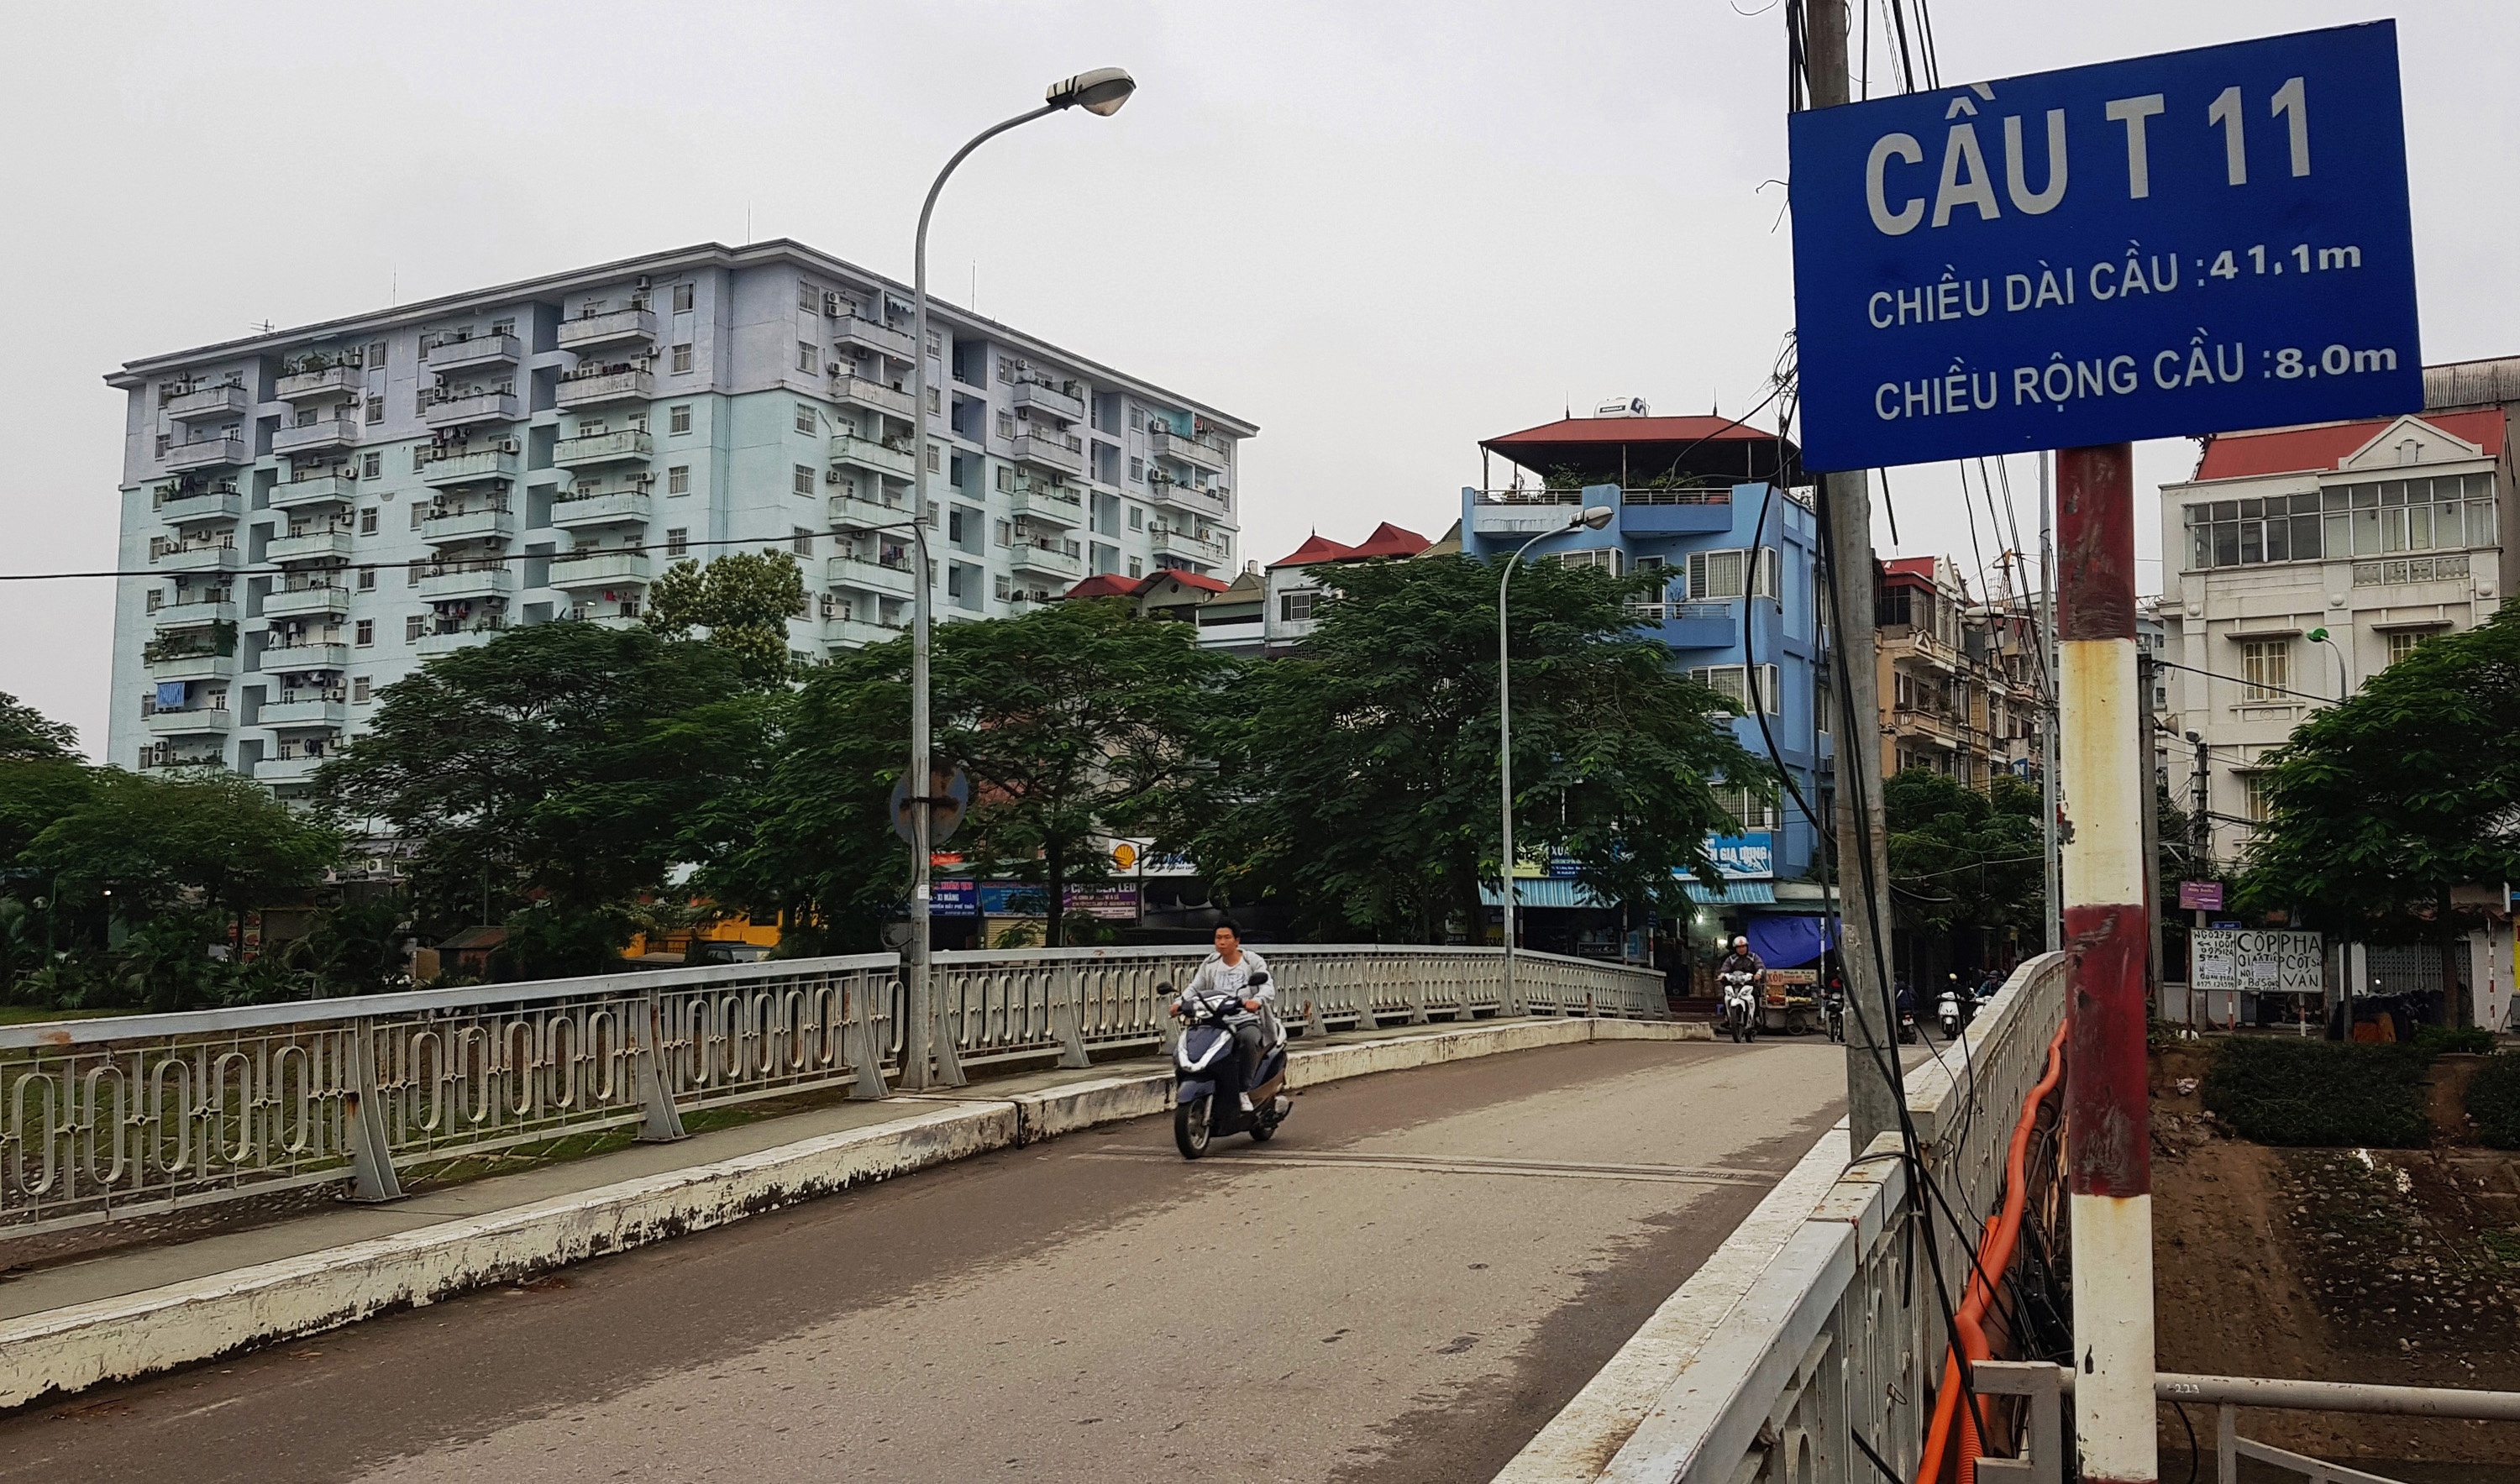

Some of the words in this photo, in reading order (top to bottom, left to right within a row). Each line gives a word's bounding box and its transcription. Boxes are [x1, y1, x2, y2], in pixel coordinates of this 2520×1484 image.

[1865, 82, 2068, 236] CẦU
[2104, 92, 2166, 200] T
[2208, 76, 2311, 186] 11
[1867, 264, 1990, 328] CHIỀU
[2005, 260, 2075, 312] DÀI
[2089, 239, 2178, 301] CẦU
[1875, 356, 1998, 421] CHIỀU
[2013, 351, 2138, 412] RỘNG
[2153, 326, 2244, 390] CẦU
[1118, 883, 1137, 893] LED
[2281, 934, 2322, 954] PHA
